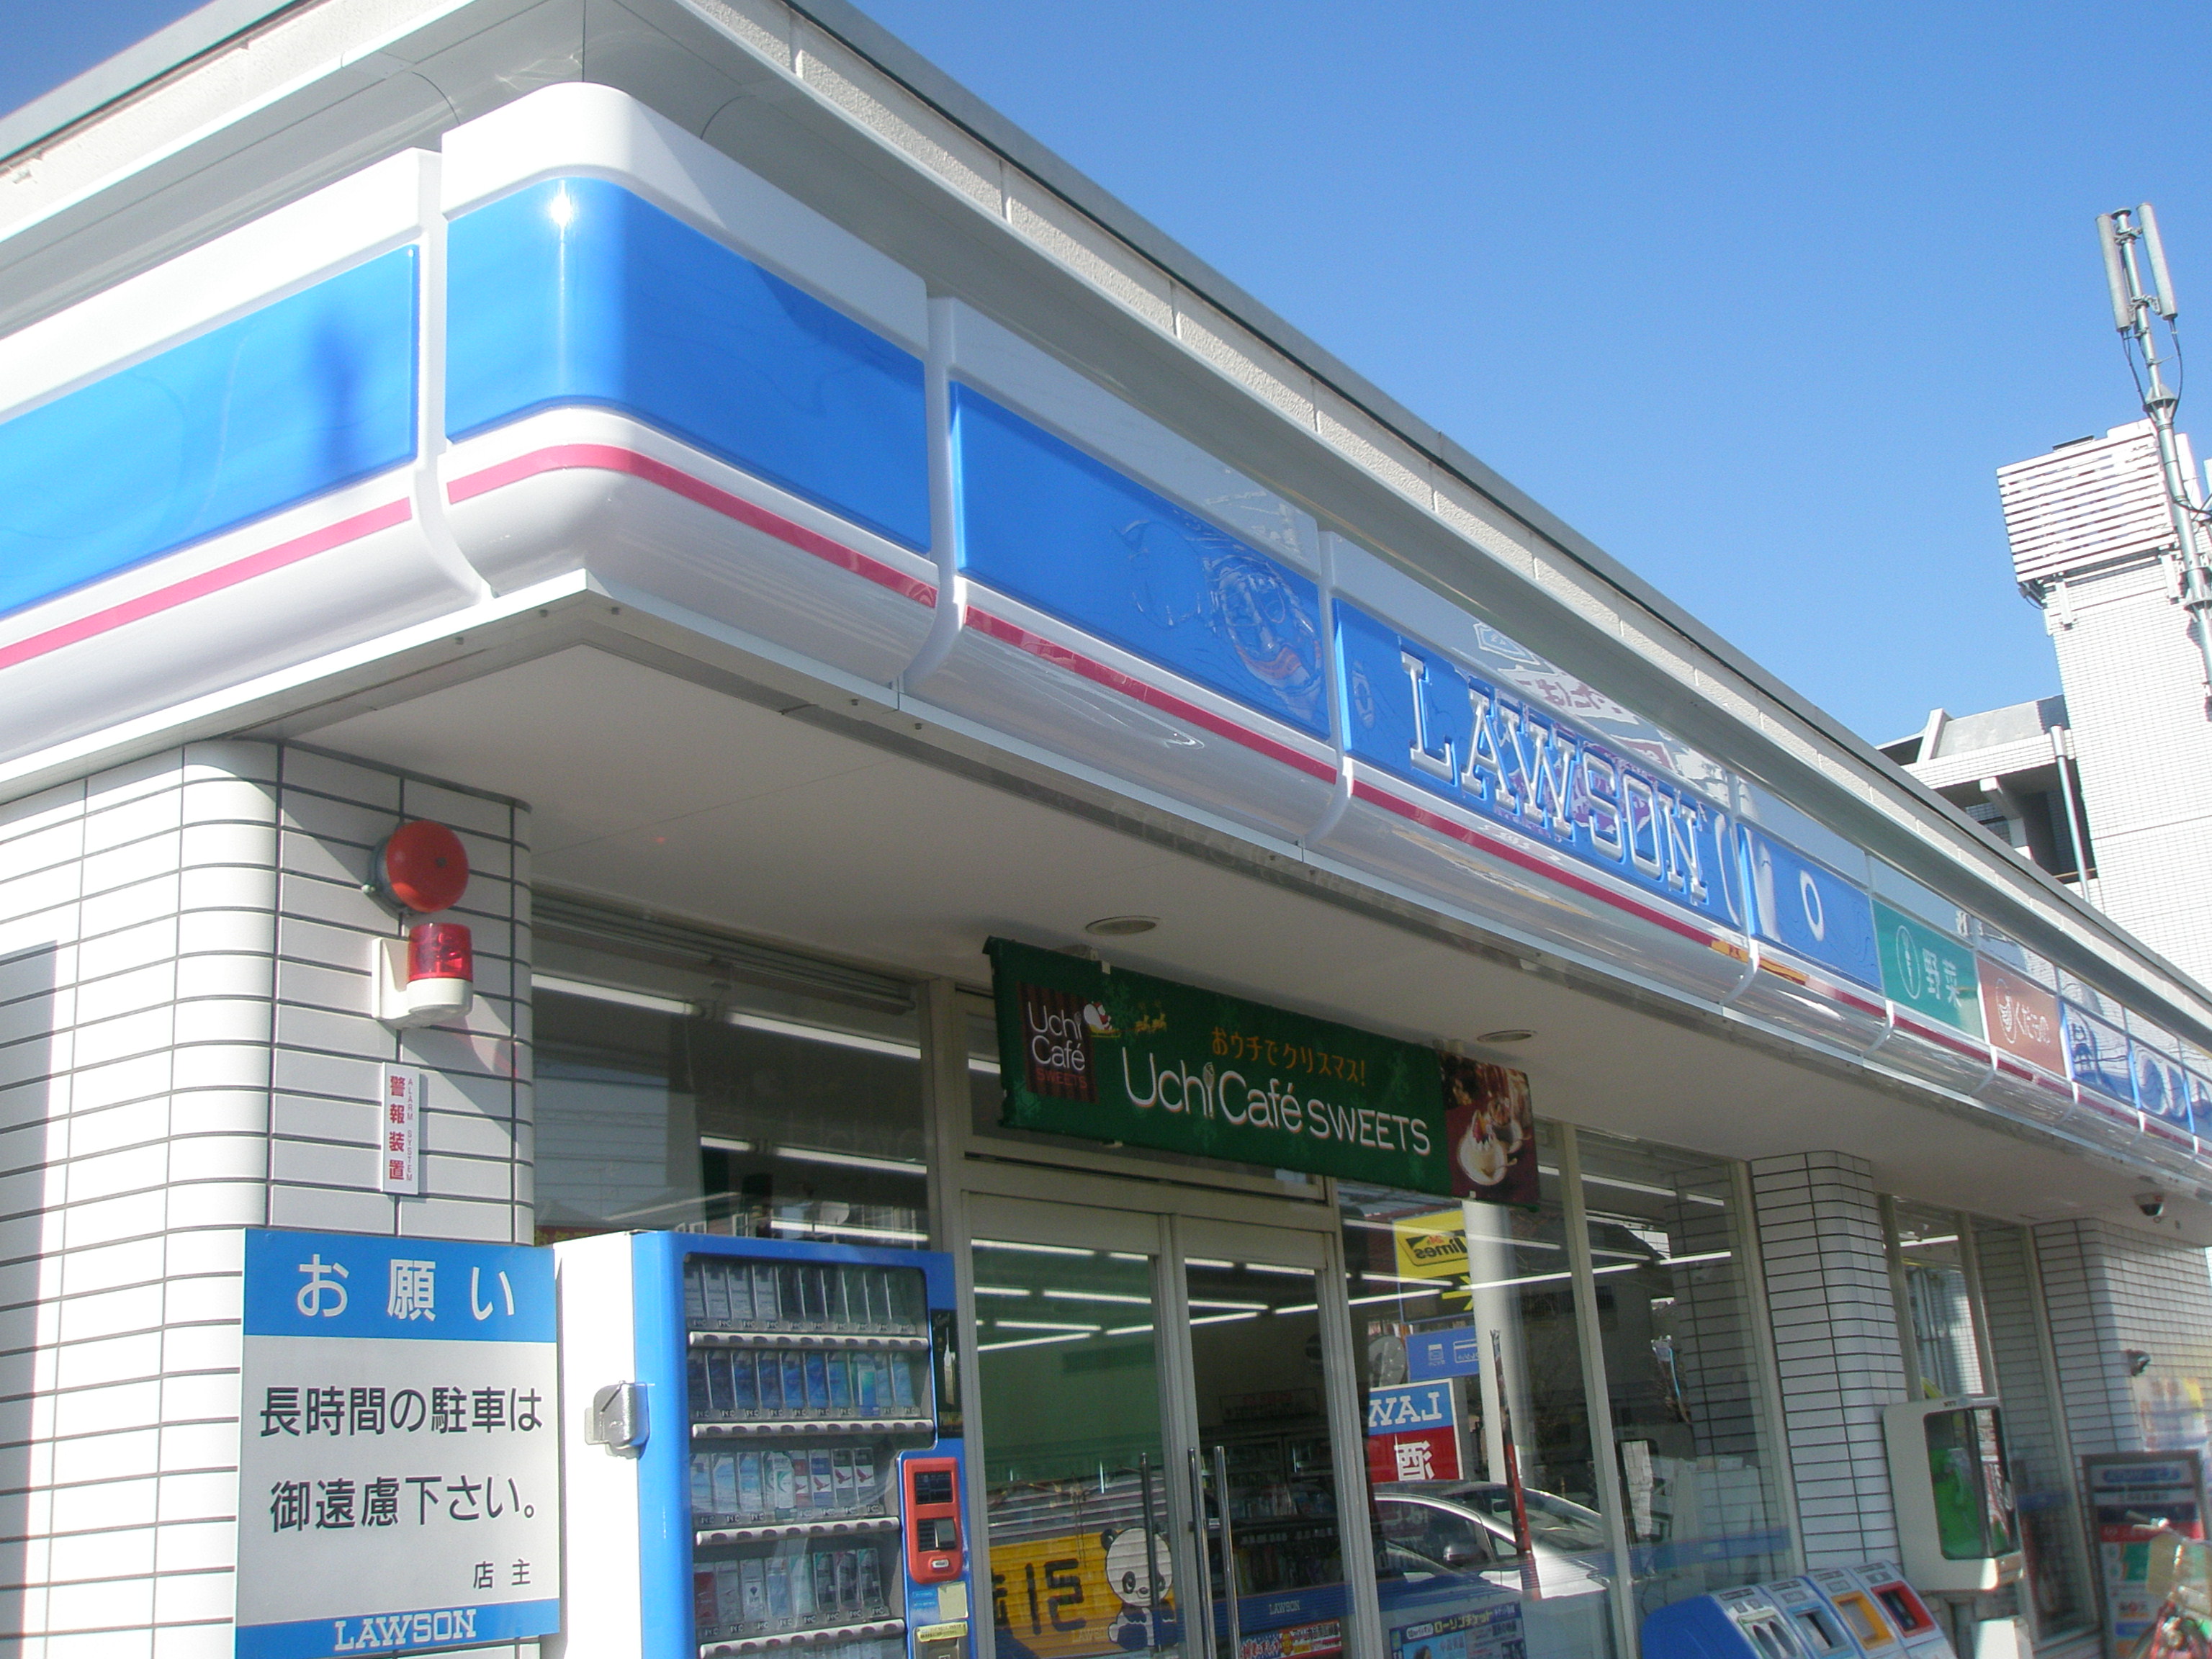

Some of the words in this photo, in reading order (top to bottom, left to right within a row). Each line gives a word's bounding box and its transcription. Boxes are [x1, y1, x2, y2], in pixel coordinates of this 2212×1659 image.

[1401, 649, 1709, 905] LAWSON
[1922, 947, 1962, 1008] 野菜
[1028, 1001, 1083, 1040] Uchi
[1031, 1035, 1086, 1071] Café
[1035, 1067, 1088, 1089] SWEETS
[389, 1074, 406, 1181] 警報装置
[1121, 1046, 1216, 1120] Uchi
[1218, 1069, 1304, 1134] Café
[1307, 1097, 1432, 1156] SWEETS
[296, 1253, 516, 1322] お願い
[259, 1385, 544, 1438] 長時間の駐車は
[269, 1473, 536, 1534] 御遠慮下さい。
[472, 1558, 533, 1591] 店主
[333, 1609, 478, 1653] LAWSON
[1269, 1599, 1300, 1615] LAWSON
